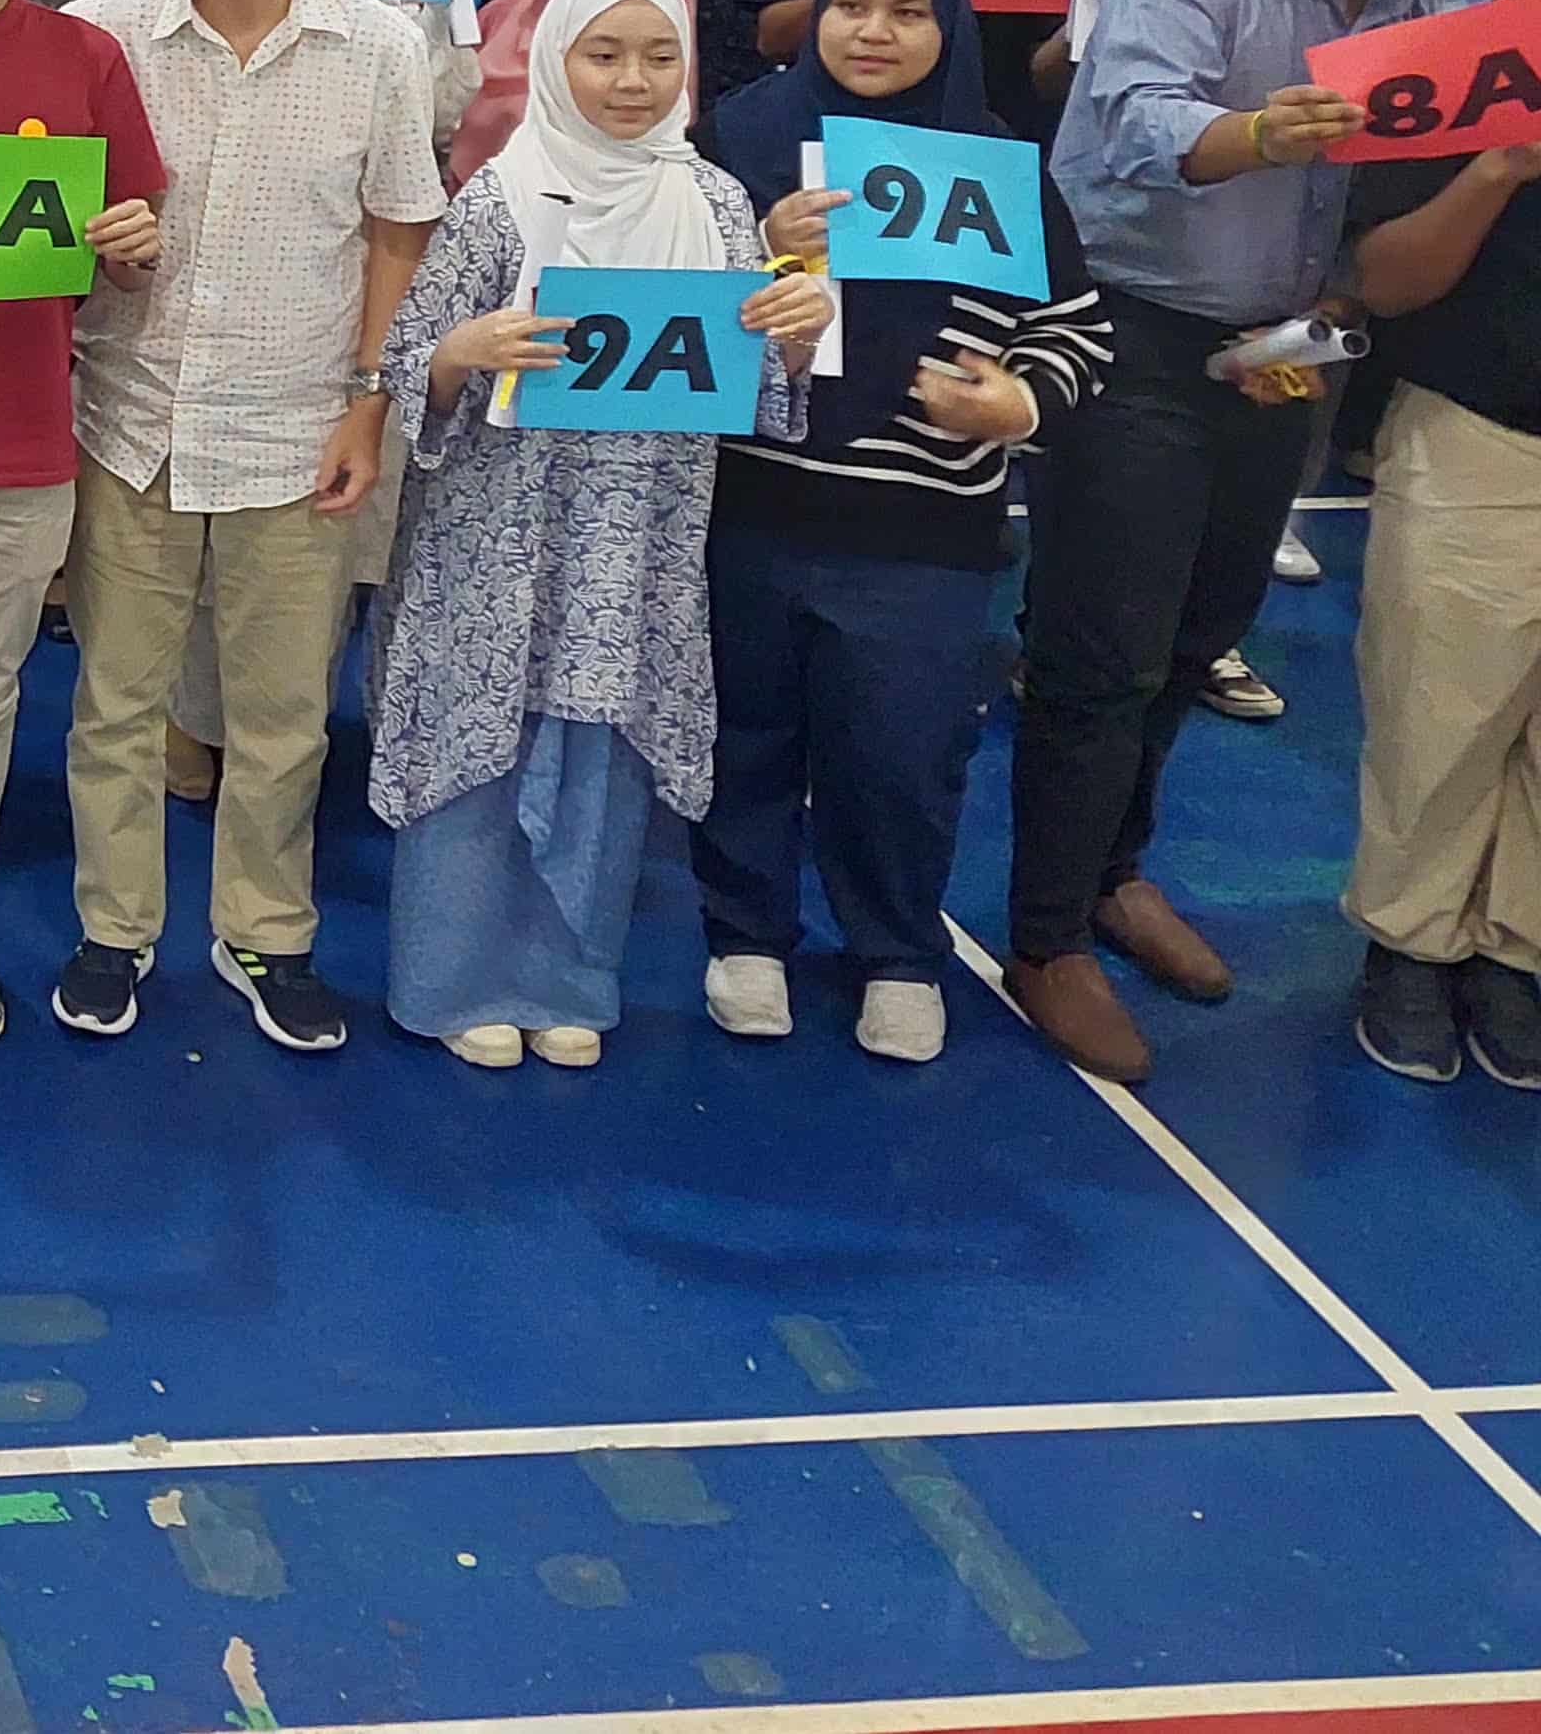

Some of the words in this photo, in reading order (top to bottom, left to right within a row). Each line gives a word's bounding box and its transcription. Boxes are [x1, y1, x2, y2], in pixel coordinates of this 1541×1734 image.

[1364, 46, 1541, 138] 8A
[862, 163, 1014, 258] 9A
[563, 312, 719, 394] 9A
